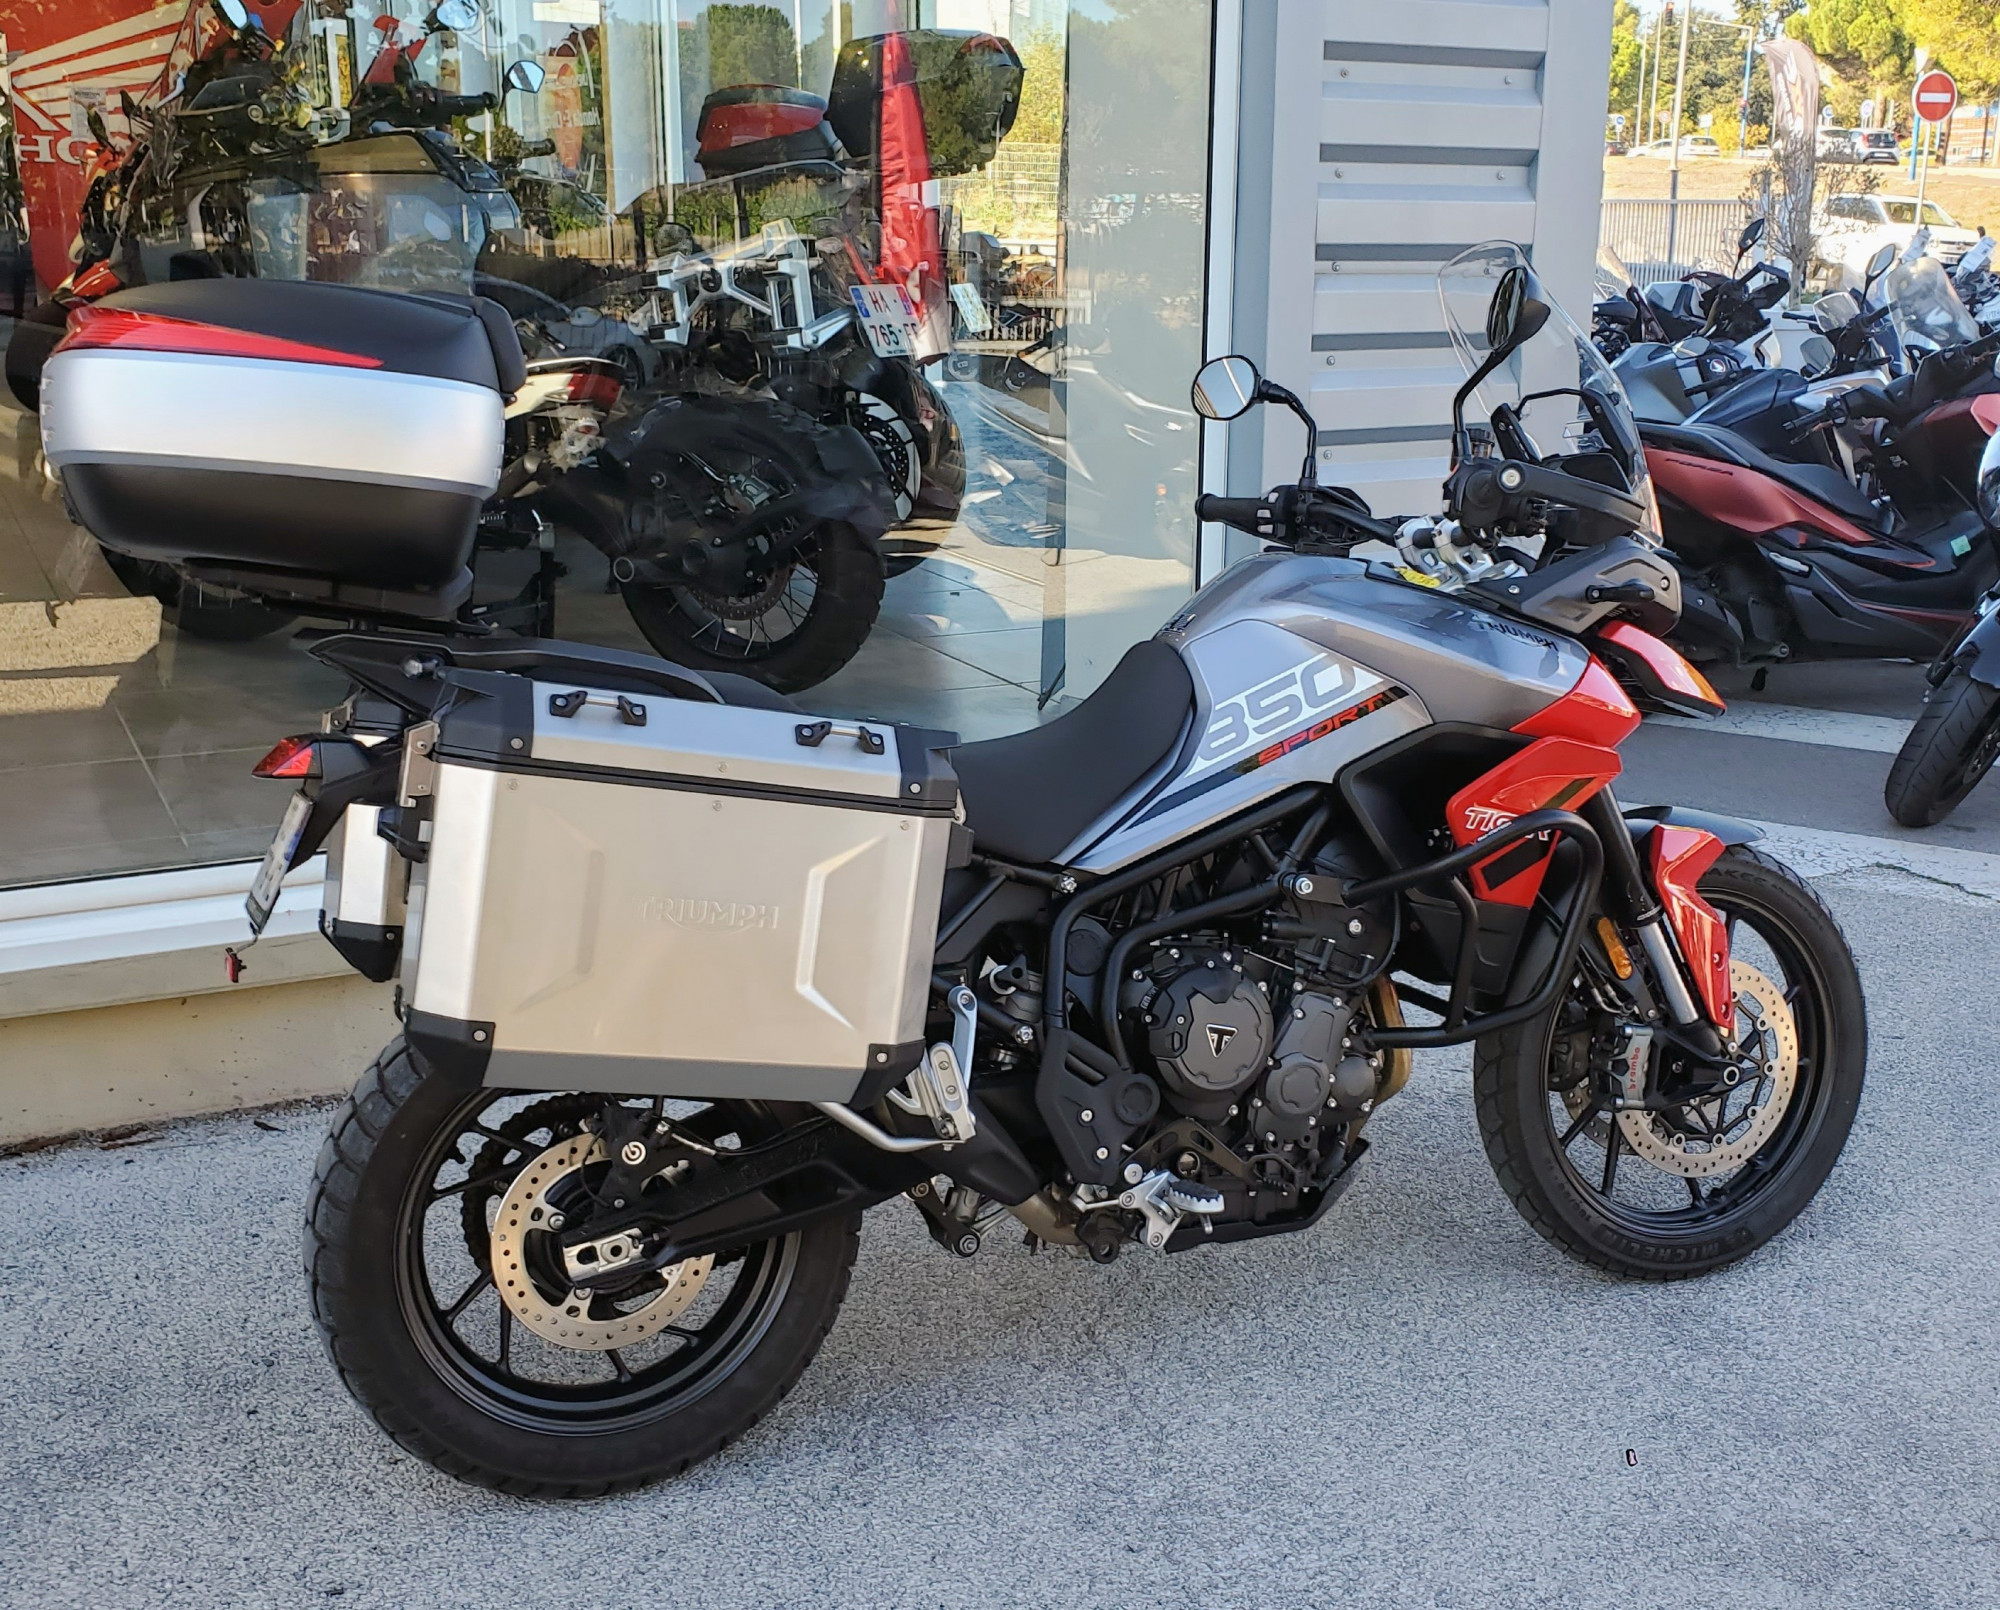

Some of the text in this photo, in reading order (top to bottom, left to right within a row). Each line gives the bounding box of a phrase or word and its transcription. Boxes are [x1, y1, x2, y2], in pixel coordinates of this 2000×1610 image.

[1199, 654, 1357, 761] 850
[1258, 693, 1384, 766] SPORT
[632, 896, 779, 929] TRIUMPH
